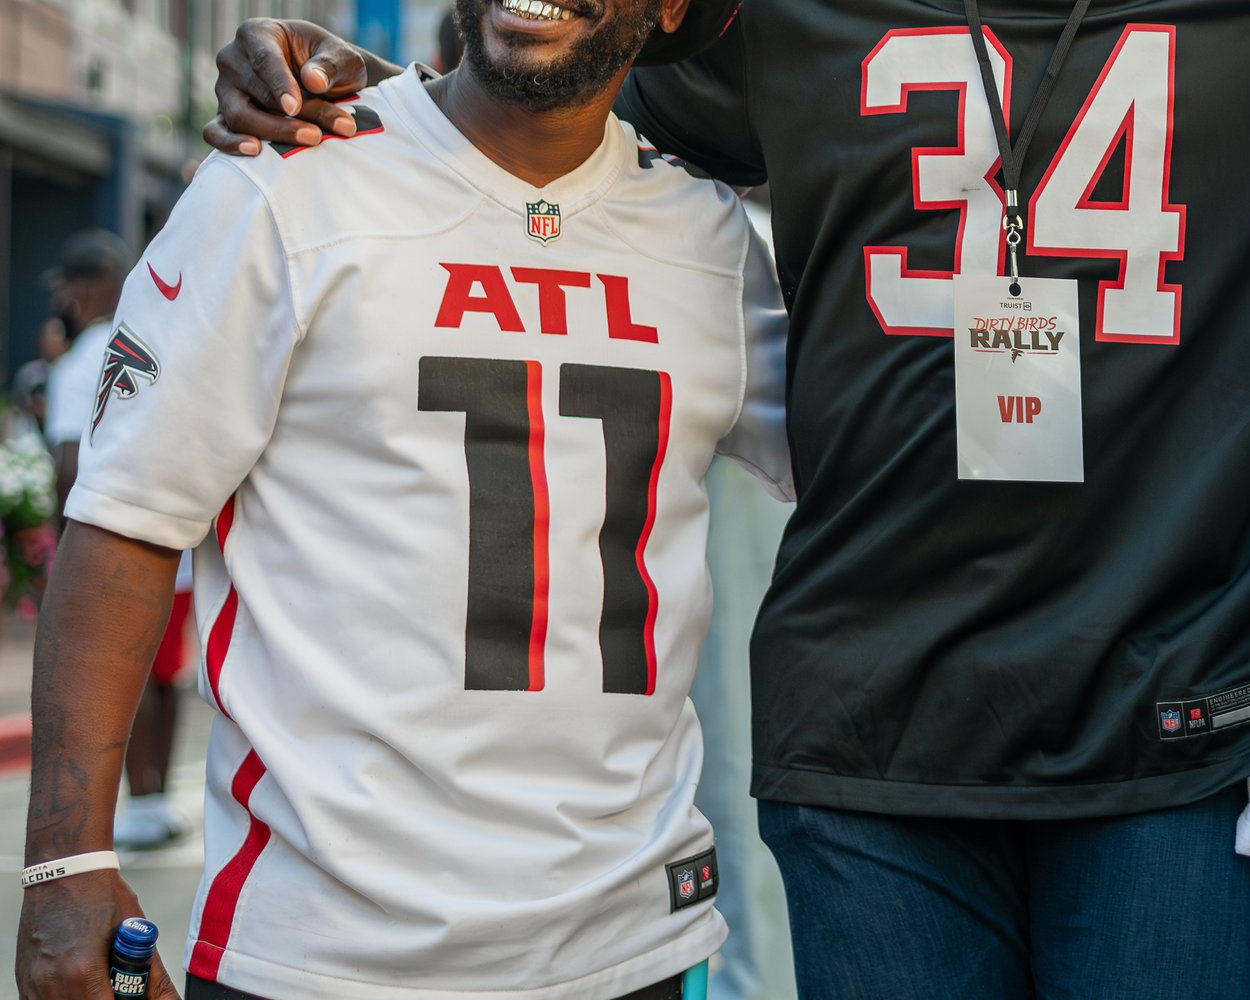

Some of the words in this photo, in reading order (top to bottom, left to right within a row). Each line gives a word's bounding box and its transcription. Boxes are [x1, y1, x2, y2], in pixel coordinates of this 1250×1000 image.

[860, 23, 1187, 346] 34
[531, 216, 559, 237] NFL
[434, 262, 659, 344] ATL
[973, 316, 1015, 332] DIRTY
[1016, 316, 1057, 331] BIRDS
[968, 328, 1064, 351] RALLY
[997, 395, 1042, 423] VIP
[418, 356, 672, 696] 11
[115, 972, 143, 985] BUD
